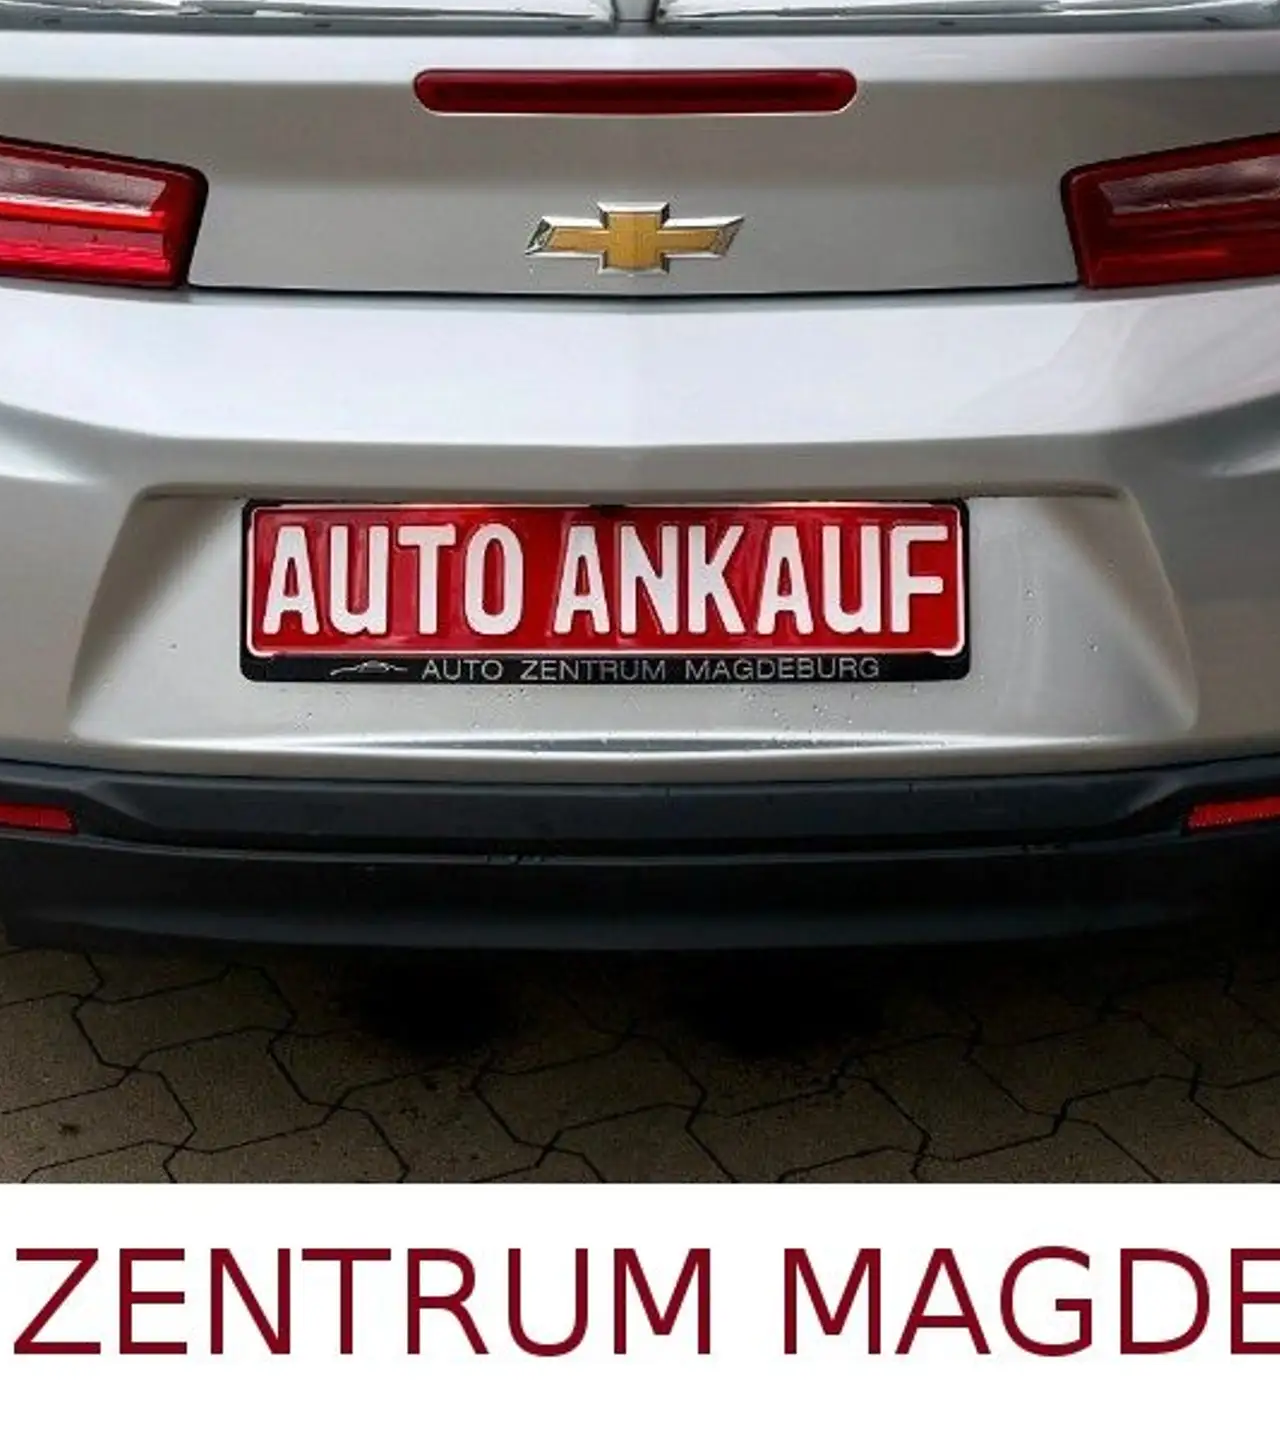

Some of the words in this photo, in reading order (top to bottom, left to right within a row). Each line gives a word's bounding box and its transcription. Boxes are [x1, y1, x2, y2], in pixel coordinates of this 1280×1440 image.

[261, 523, 524, 635] AUTO
[552, 523, 949, 635] ANKAUF
[421, 657, 504, 681] AUTO
[520, 657, 666, 681] ZENTRUM
[685, 656, 879, 681] MAGDEBURG
